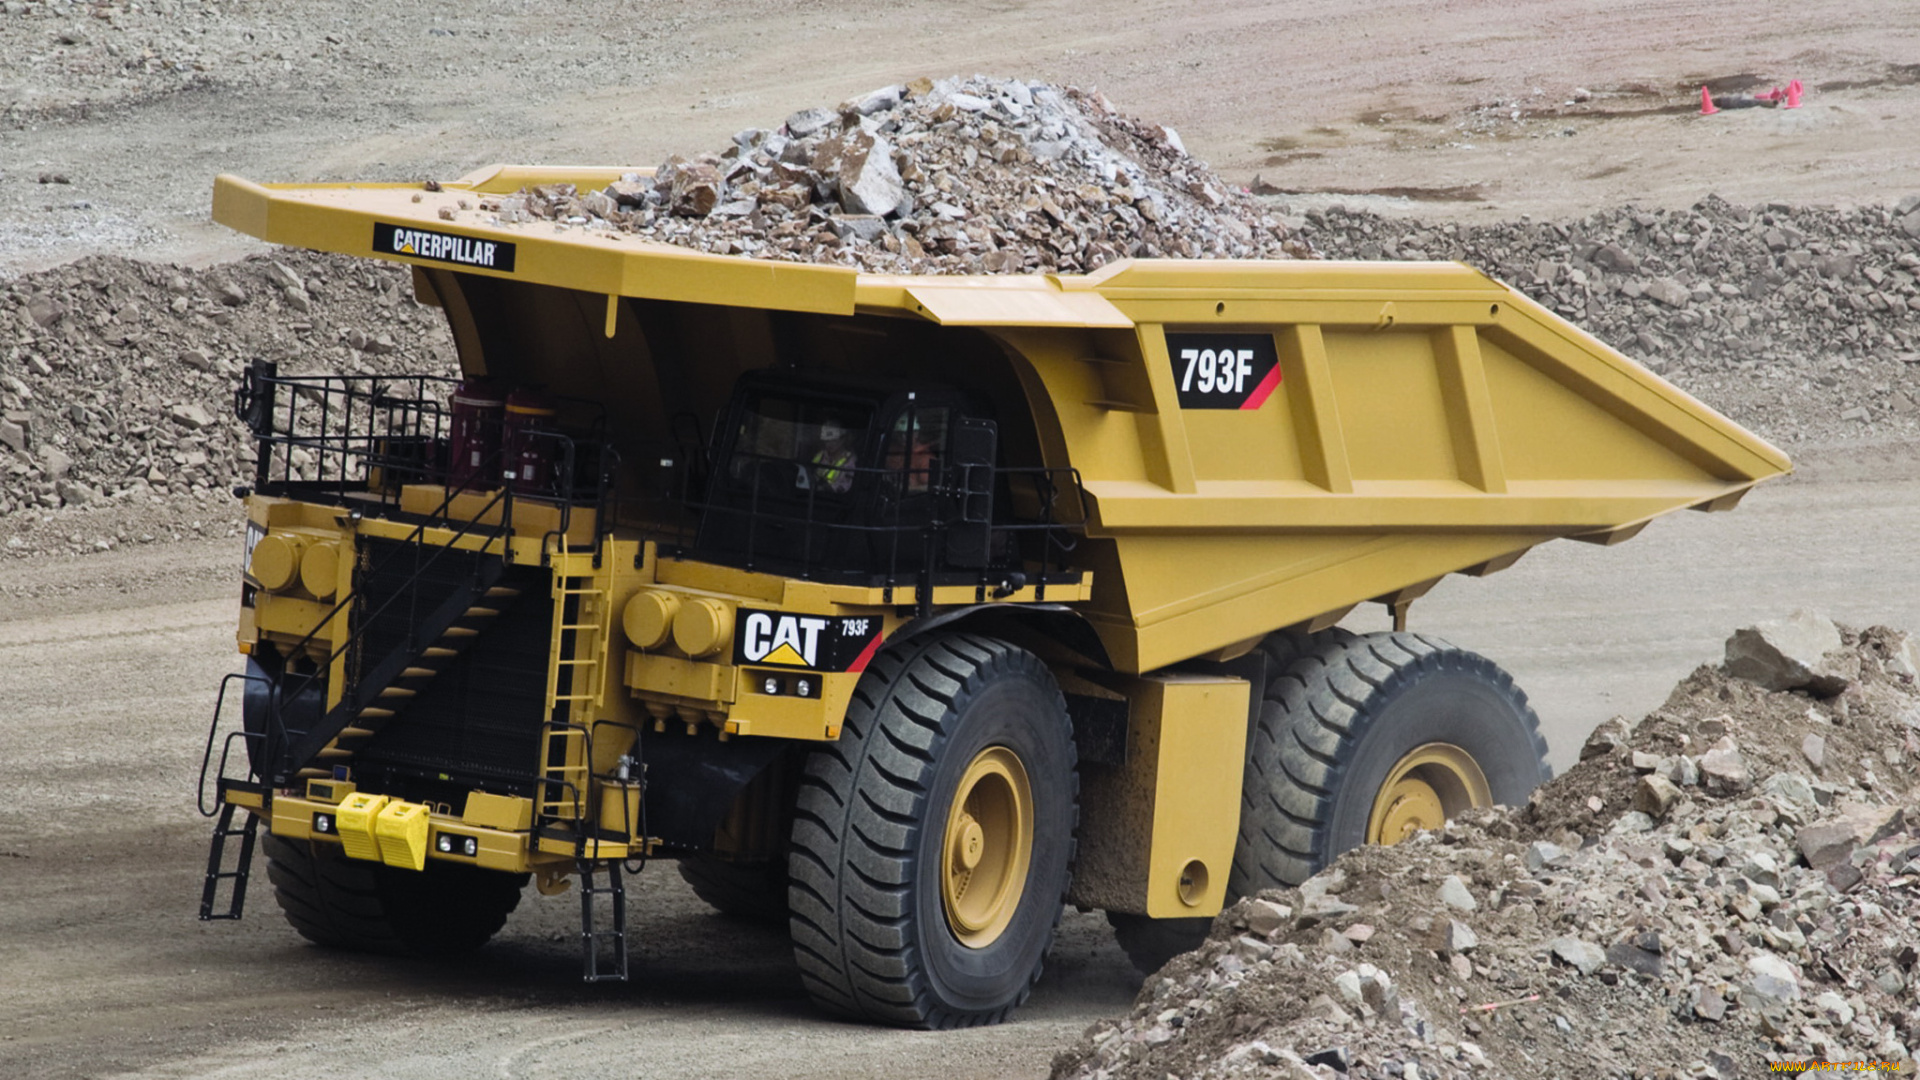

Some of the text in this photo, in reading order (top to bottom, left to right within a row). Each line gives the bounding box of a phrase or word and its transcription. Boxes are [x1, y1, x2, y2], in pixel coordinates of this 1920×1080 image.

[393, 228, 495, 266] CATERPILLAR
[1181, 349, 1253, 393] 793F
[744, 613, 869, 667] CAT 793F
